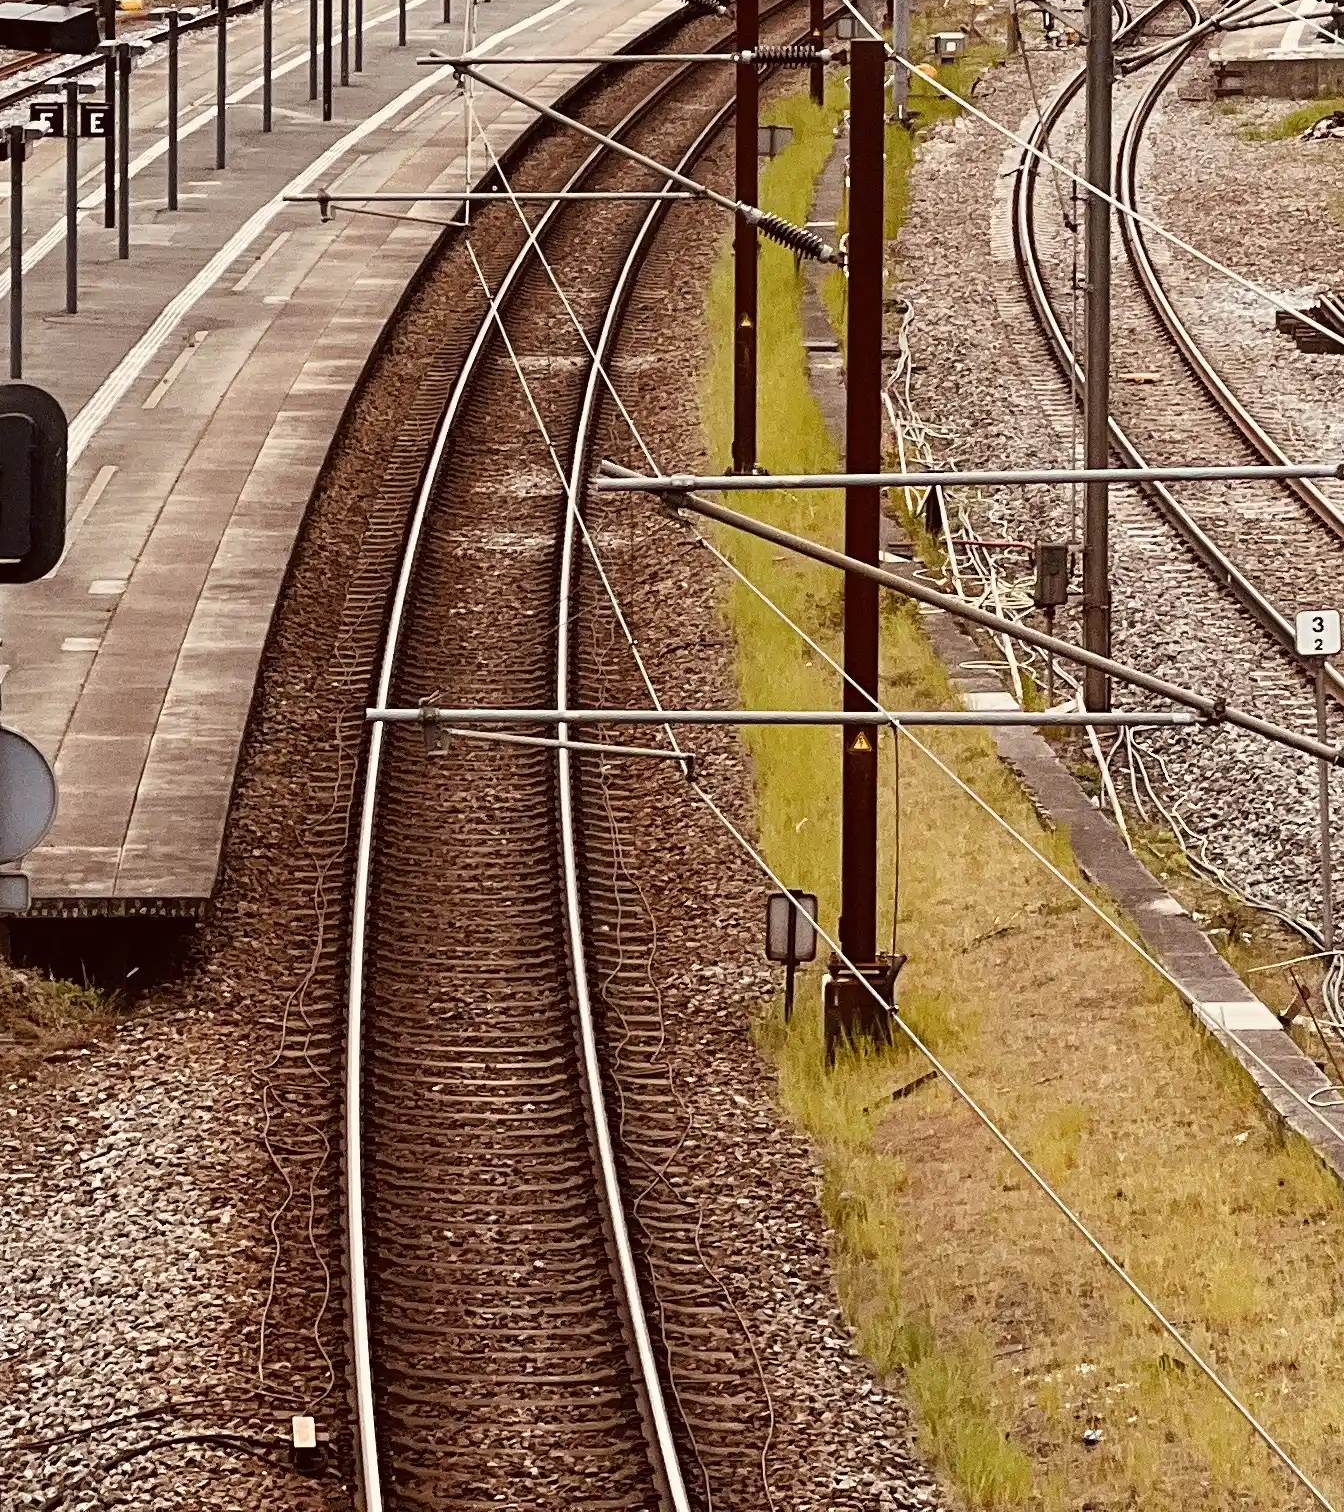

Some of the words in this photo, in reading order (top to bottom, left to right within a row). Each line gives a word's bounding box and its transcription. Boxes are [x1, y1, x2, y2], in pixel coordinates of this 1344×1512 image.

[90, 112, 105, 134] E
[1312, 616, 1325, 633] 3
[1314, 638, 1324, 651] 2
